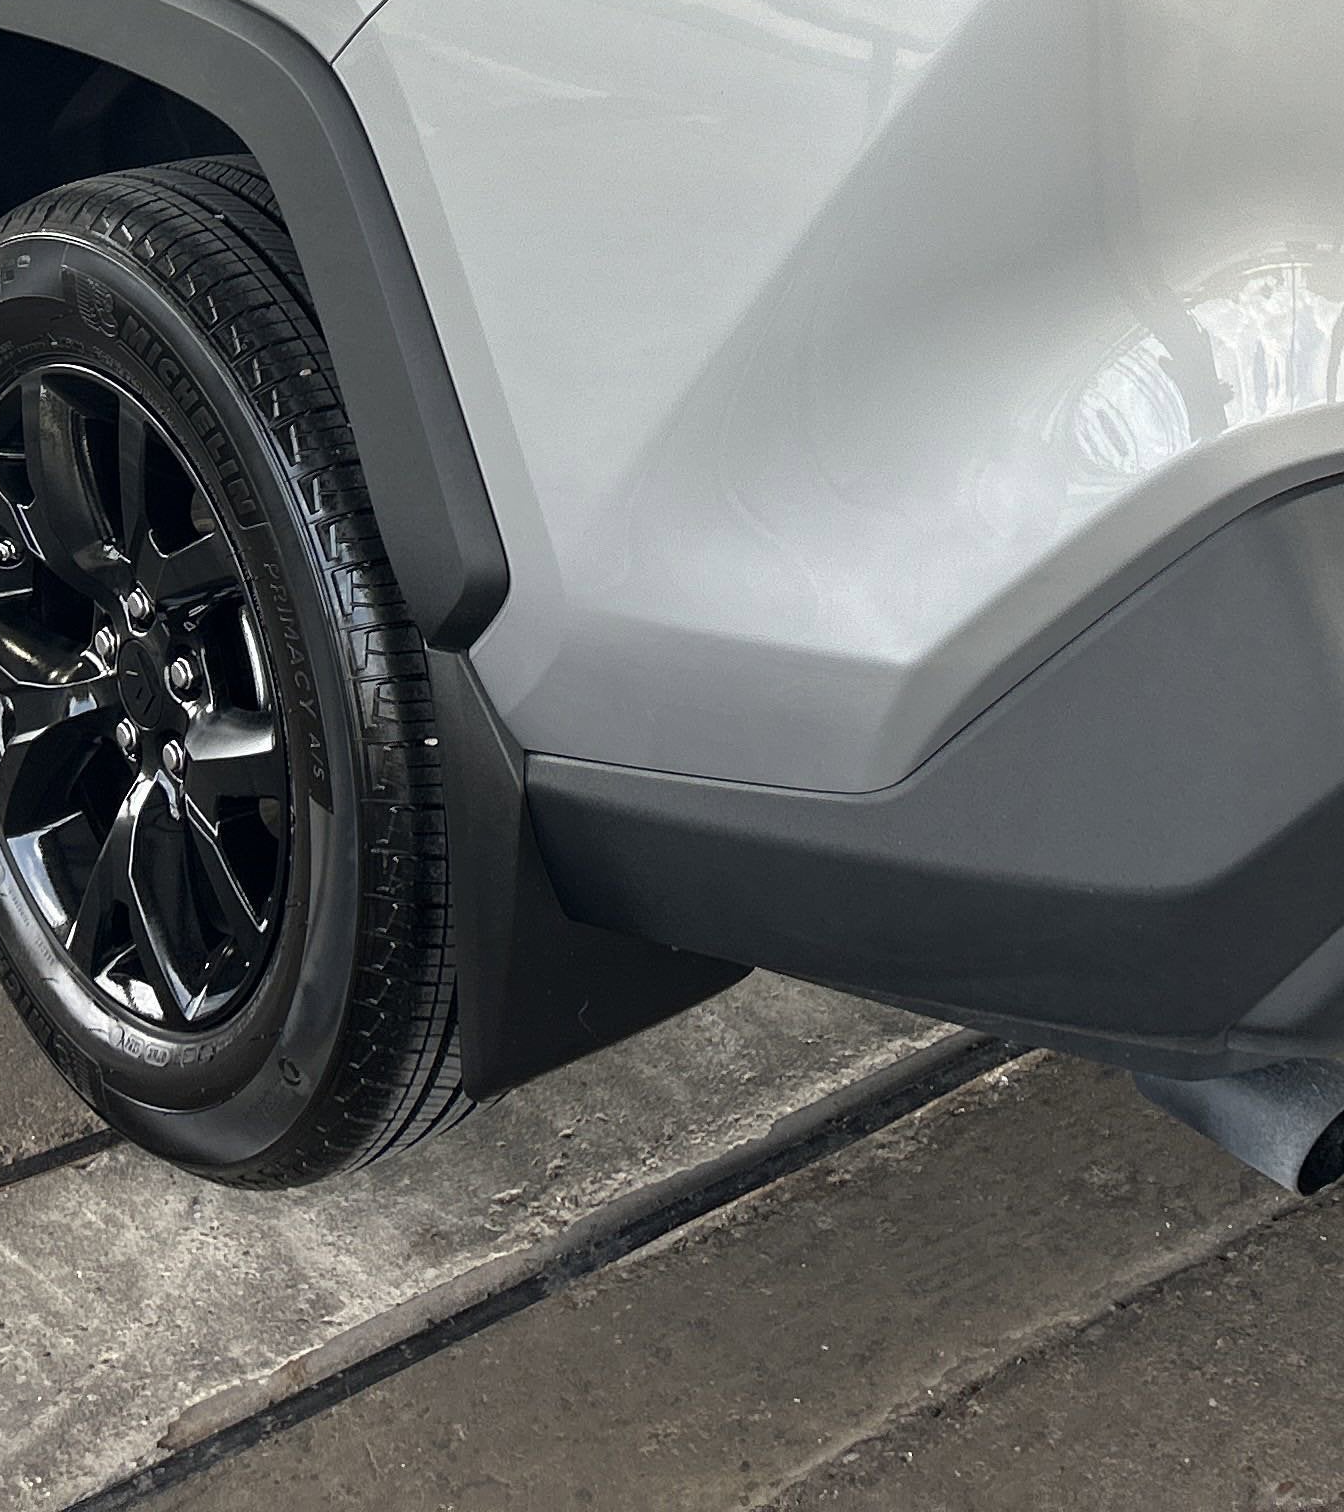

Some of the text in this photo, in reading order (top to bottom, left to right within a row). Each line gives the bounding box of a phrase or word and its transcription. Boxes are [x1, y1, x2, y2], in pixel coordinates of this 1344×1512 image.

[119, 314, 256, 514] MICHELIN
[262, 561, 326, 785] PRIMACY A/S
